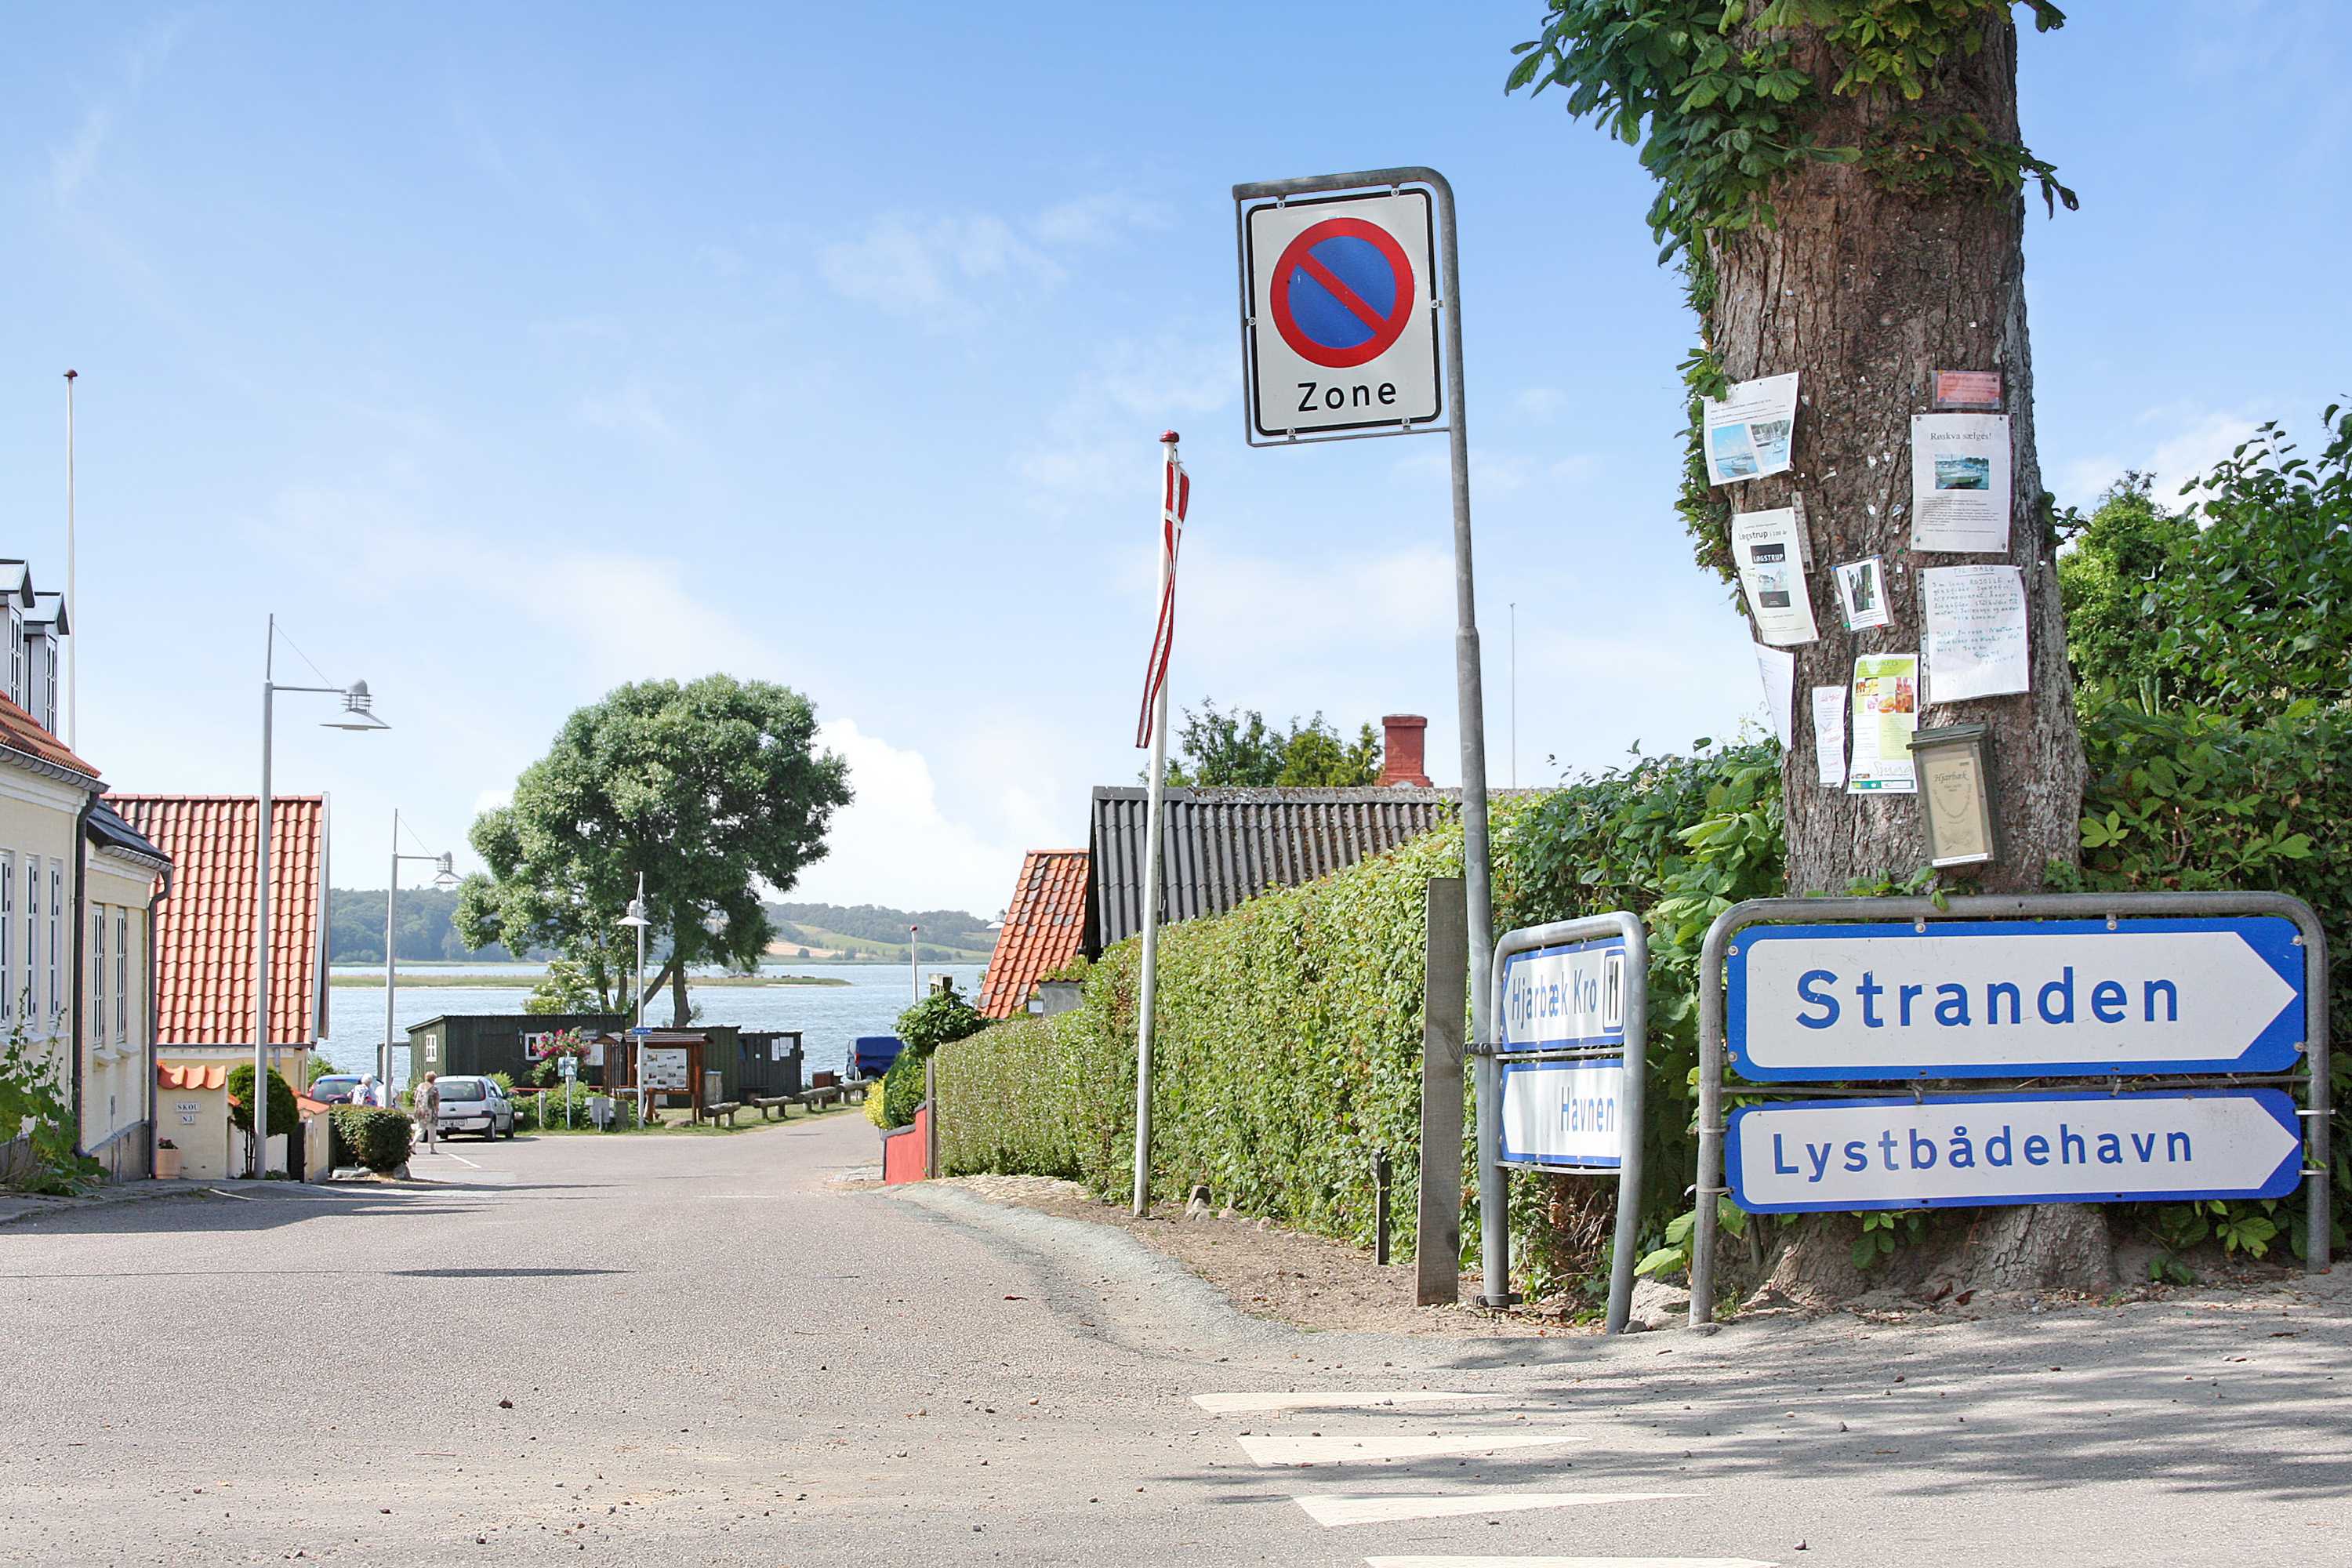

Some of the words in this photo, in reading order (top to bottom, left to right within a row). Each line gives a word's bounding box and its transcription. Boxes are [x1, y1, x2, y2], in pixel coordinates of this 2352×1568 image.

[1298, 382, 1396, 412] Zone
[1512, 972, 1568, 1029] Hjarbæk
[1573, 969, 1597, 1014] Kro
[1796, 967, 2178, 1029] Stranden
[1561, 1087, 1615, 1132] Havnen
[1773, 1123, 2193, 1183] Lystbådehavn
